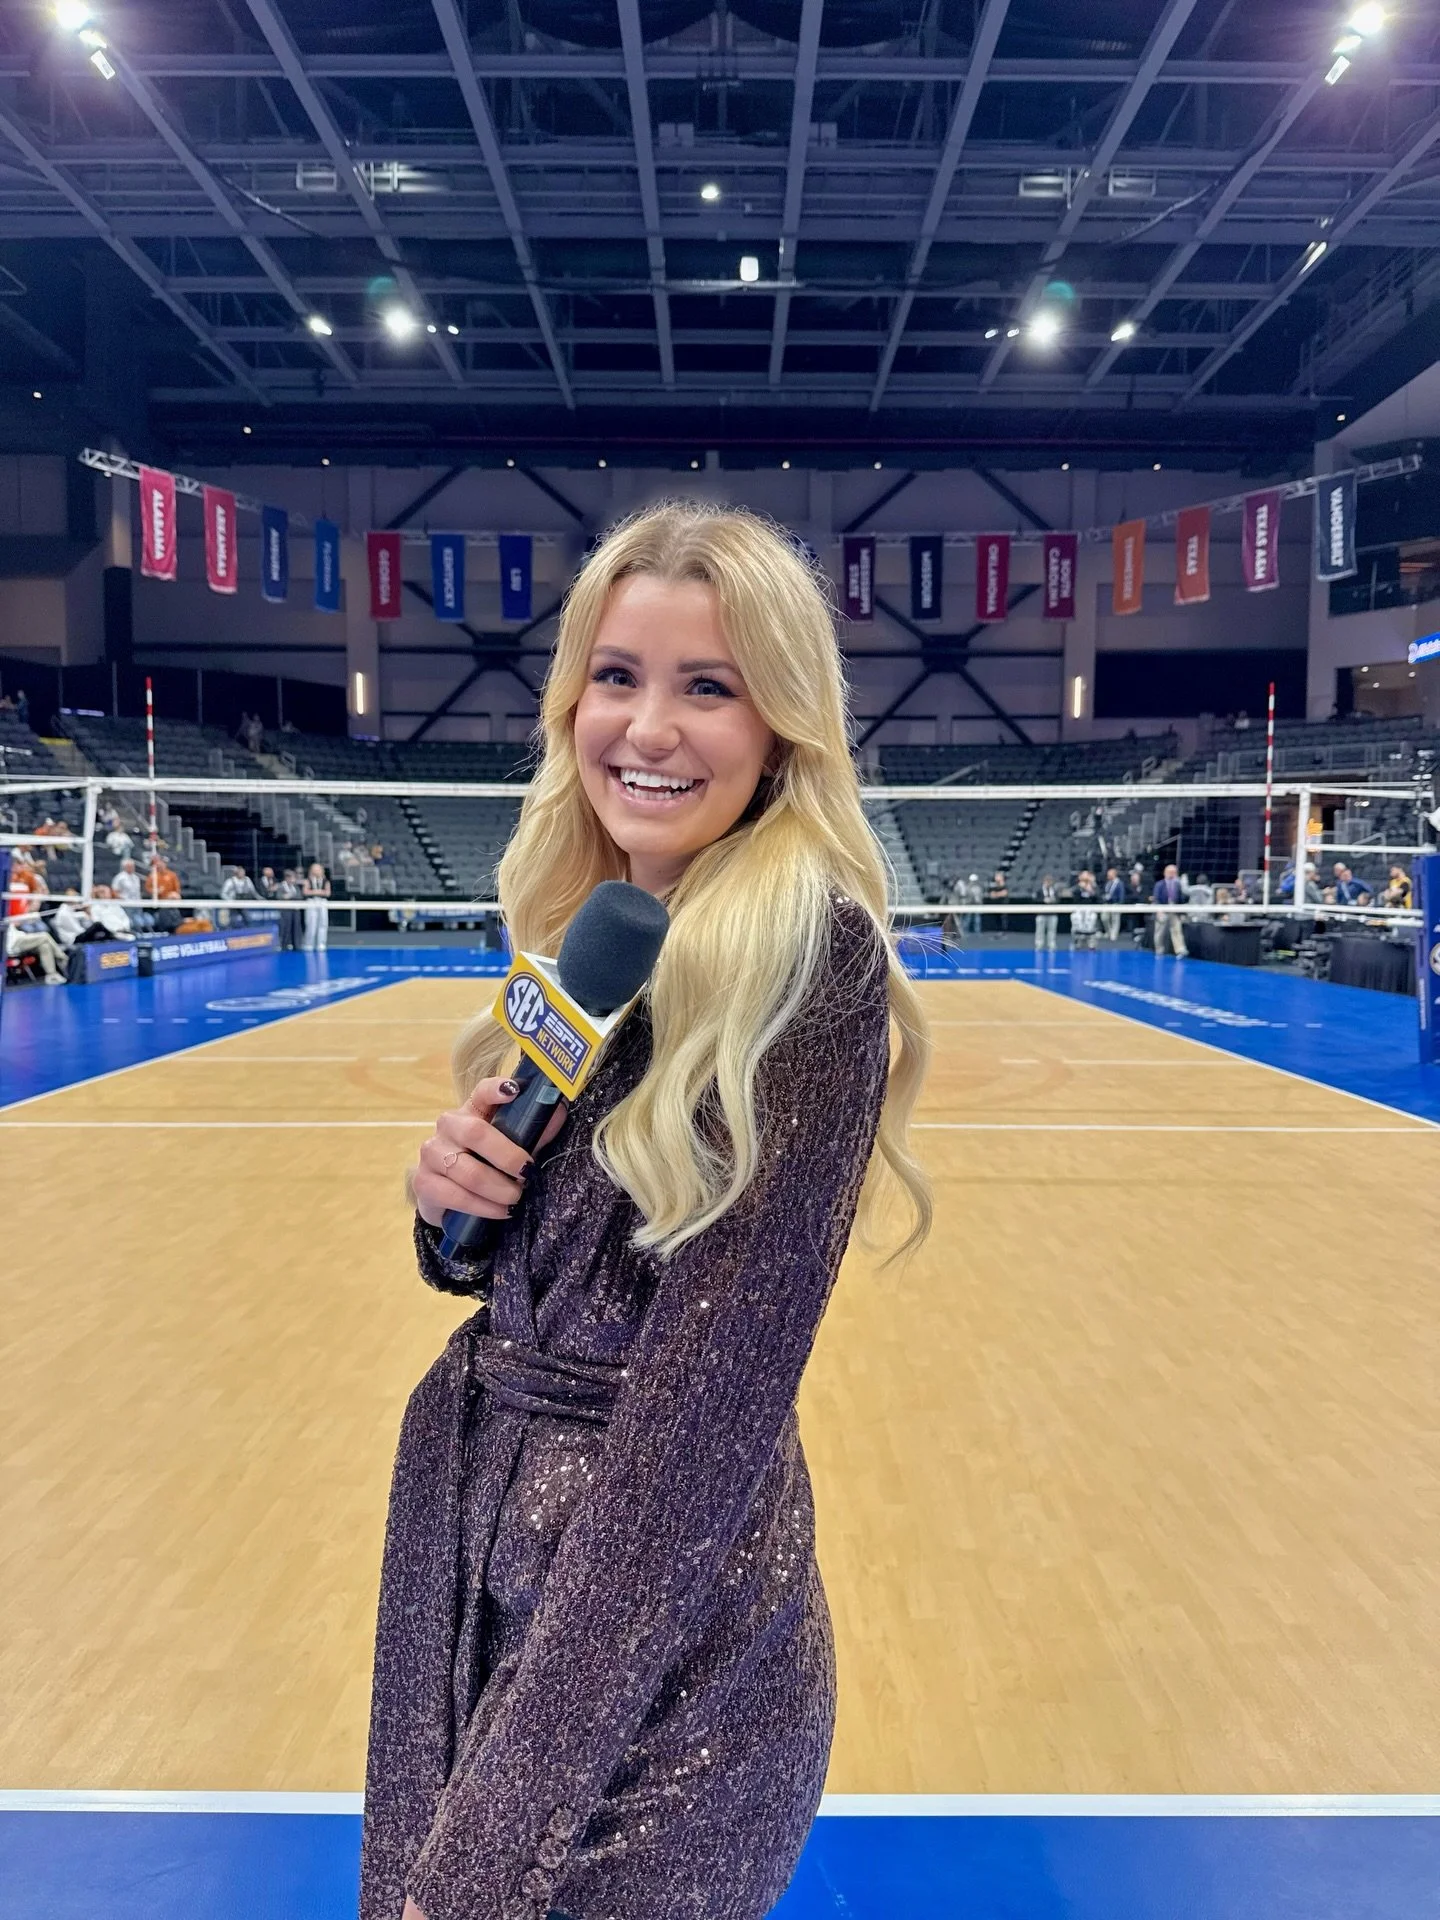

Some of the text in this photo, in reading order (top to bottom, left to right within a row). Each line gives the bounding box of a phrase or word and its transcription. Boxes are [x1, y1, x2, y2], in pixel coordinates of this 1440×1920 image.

[152, 489, 164, 560] ALABAMA
[216, 505, 226, 577] ARKANSAS
[1254, 504, 1269, 579] TEXAS A&M
[1330, 487, 1344, 566] VANDERBILT
[270, 528, 280, 581] AUBURN
[379, 549, 389, 605] GEORGIA
[443, 547, 454, 608] KENTUCKY
[510, 568, 521, 591] LSU
[849, 564, 859, 598] STATE
[860, 549, 870, 614] MISSISSIPPI
[921, 551, 932, 608] MISSOURI
[987, 544, 999, 614] OKLAHOMA
[1048, 548, 1060, 608] CAROLINA
[1060, 558, 1070, 598] SOUTH
[1187, 535, 1199, 575] TEXAS
[507, 978, 545, 1032] SEC
[536, 1028, 575, 1075] NETWORK
[543, 1011, 584, 1056] ESPN
